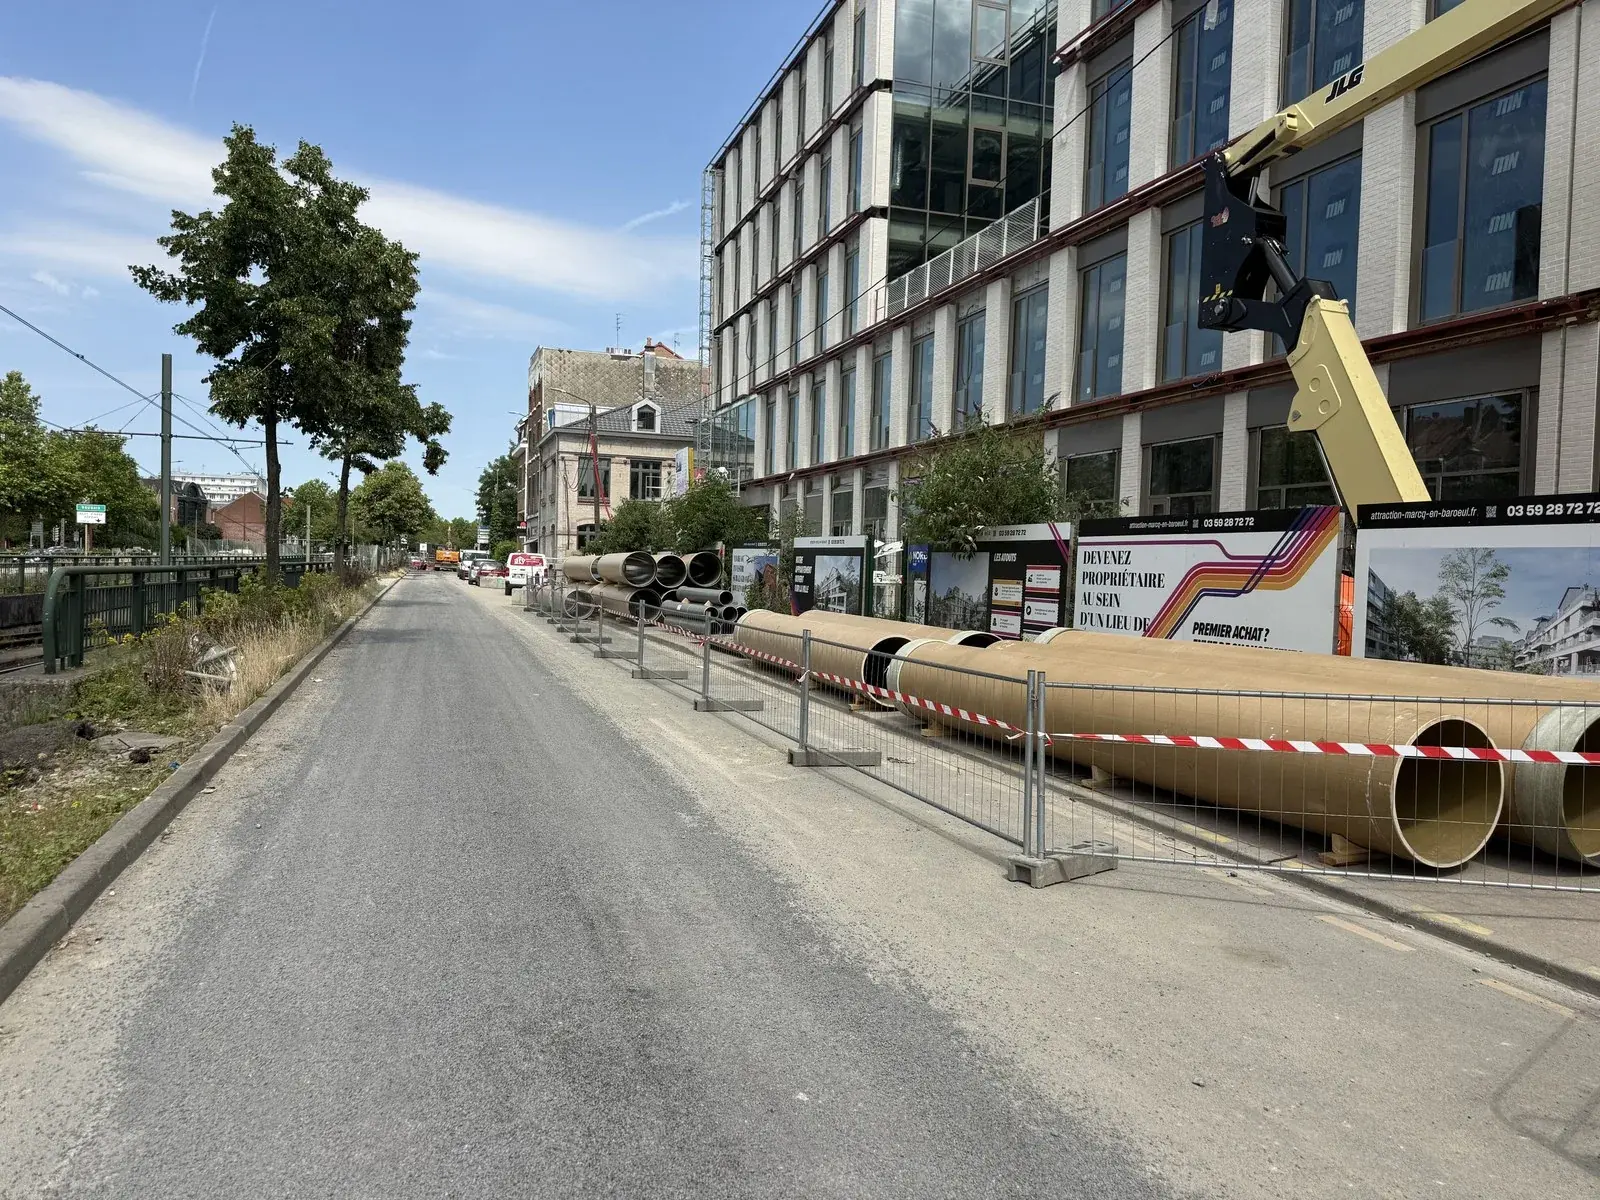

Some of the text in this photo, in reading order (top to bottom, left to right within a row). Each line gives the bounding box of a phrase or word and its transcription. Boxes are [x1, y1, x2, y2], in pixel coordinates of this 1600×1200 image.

[1325, 65, 1365, 104] JLG
[1506, 501, 1600, 517] 03 59 28 72 72
[1203, 517, 1255, 527] 03 59 28 72 72
[1083, 550, 1132, 565] DEVENEZ
[1081, 568, 1166, 589] PROPRIÉTAIRE
[1081, 591, 1121, 608] AU SEIN
[1079, 611, 1151, 633] D'UN LIEU DE
[1192, 621, 1233, 639] PREMIER
[1231, 625, 1264, 642] ACHAT
